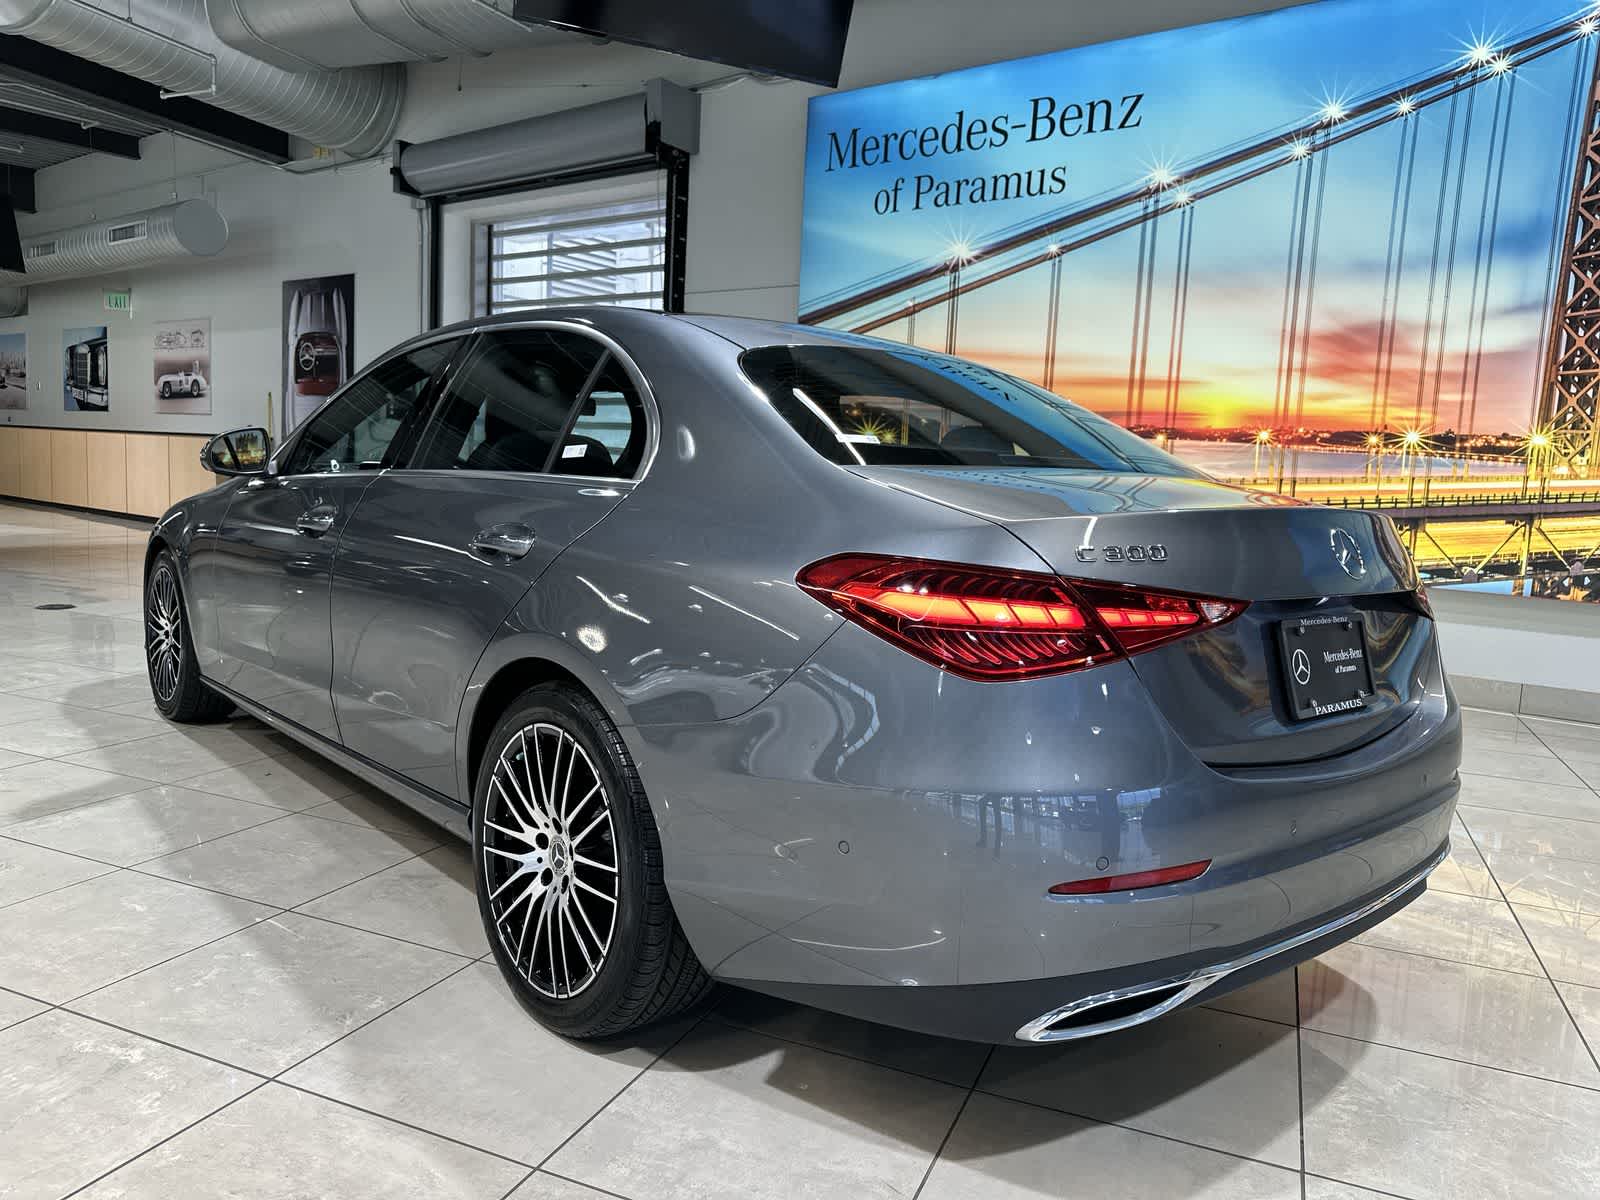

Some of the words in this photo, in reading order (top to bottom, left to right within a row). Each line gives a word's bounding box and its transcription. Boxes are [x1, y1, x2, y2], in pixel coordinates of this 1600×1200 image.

[825, 93, 1145, 172] Mercedes-Benz
[873, 178, 903, 215] of
[912, 165, 1067, 211] Paramus
[1075, 545, 1097, 563] C
[1103, 544, 1168, 563] 300
[1300, 616, 1348, 625] Mercedes-Benz
[1323, 648, 1362, 661] Mercedes-Benz
[1315, 699, 1362, 715] PARAMUS
